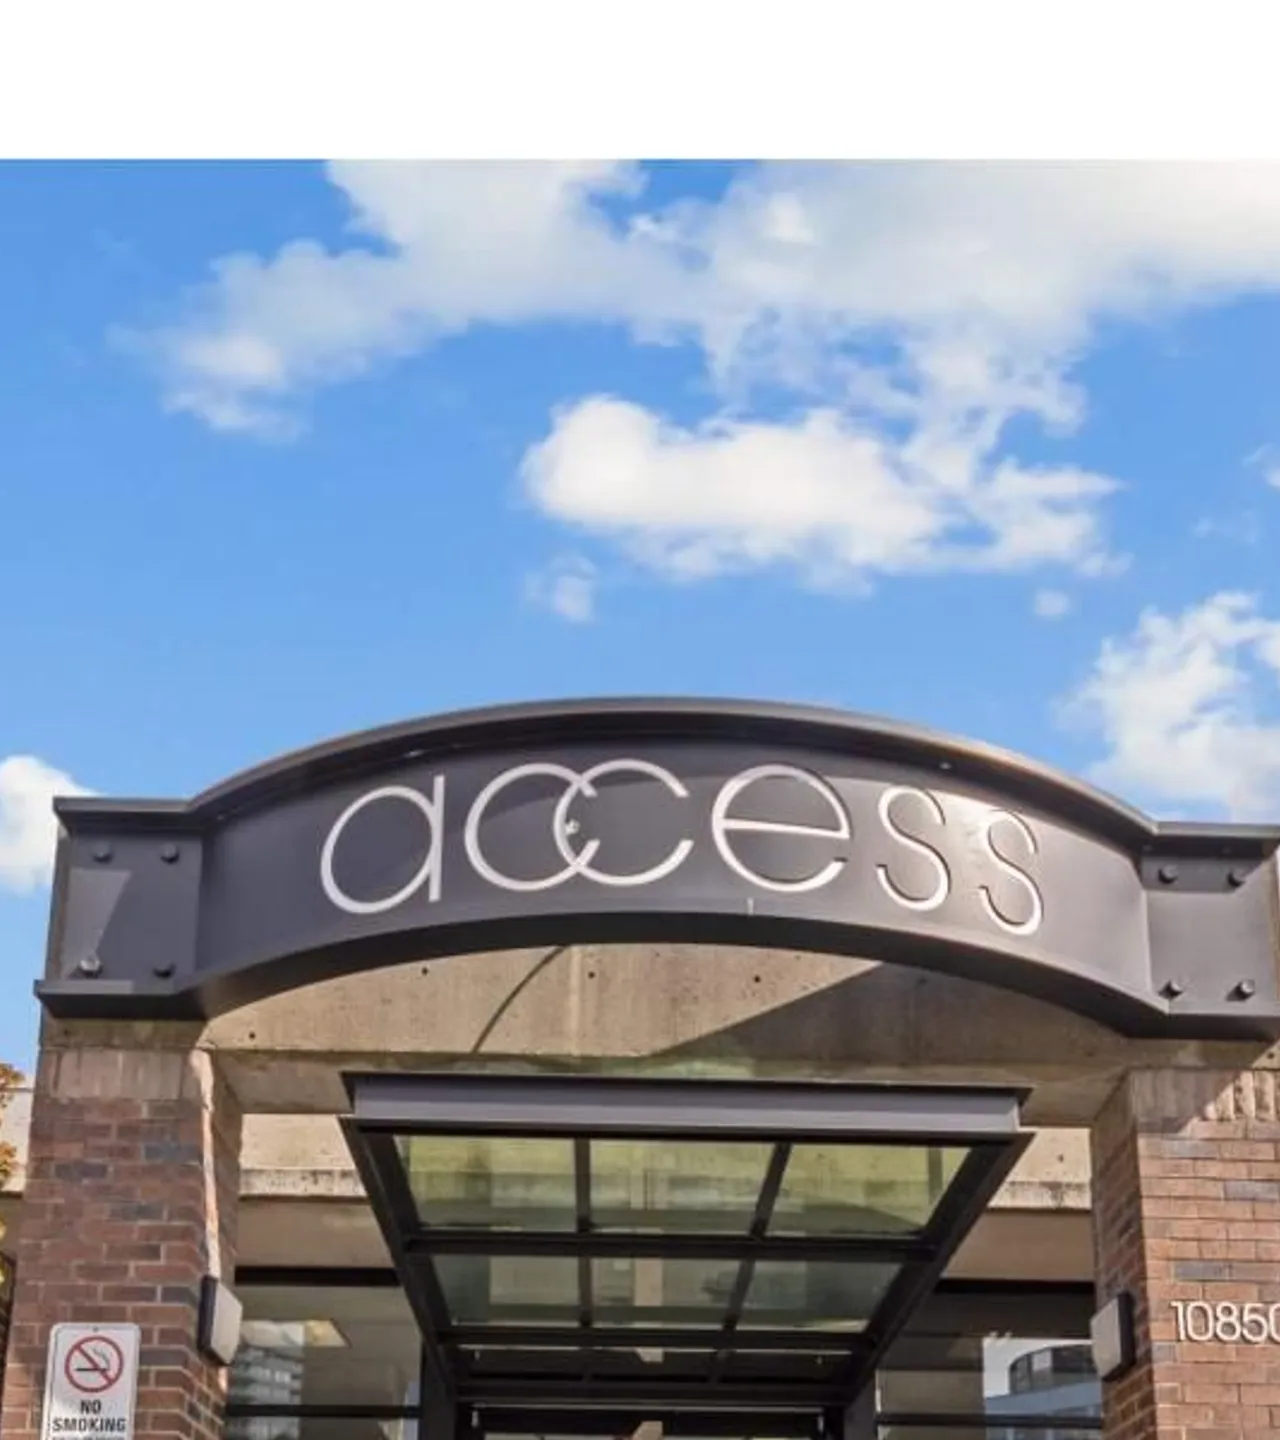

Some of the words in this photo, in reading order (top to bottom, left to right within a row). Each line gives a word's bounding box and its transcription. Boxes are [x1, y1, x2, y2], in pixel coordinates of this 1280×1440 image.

[321, 758, 1042, 934] access
[80, 1400, 102, 1414] NO
[53, 1418, 126, 1432] SMOKING
